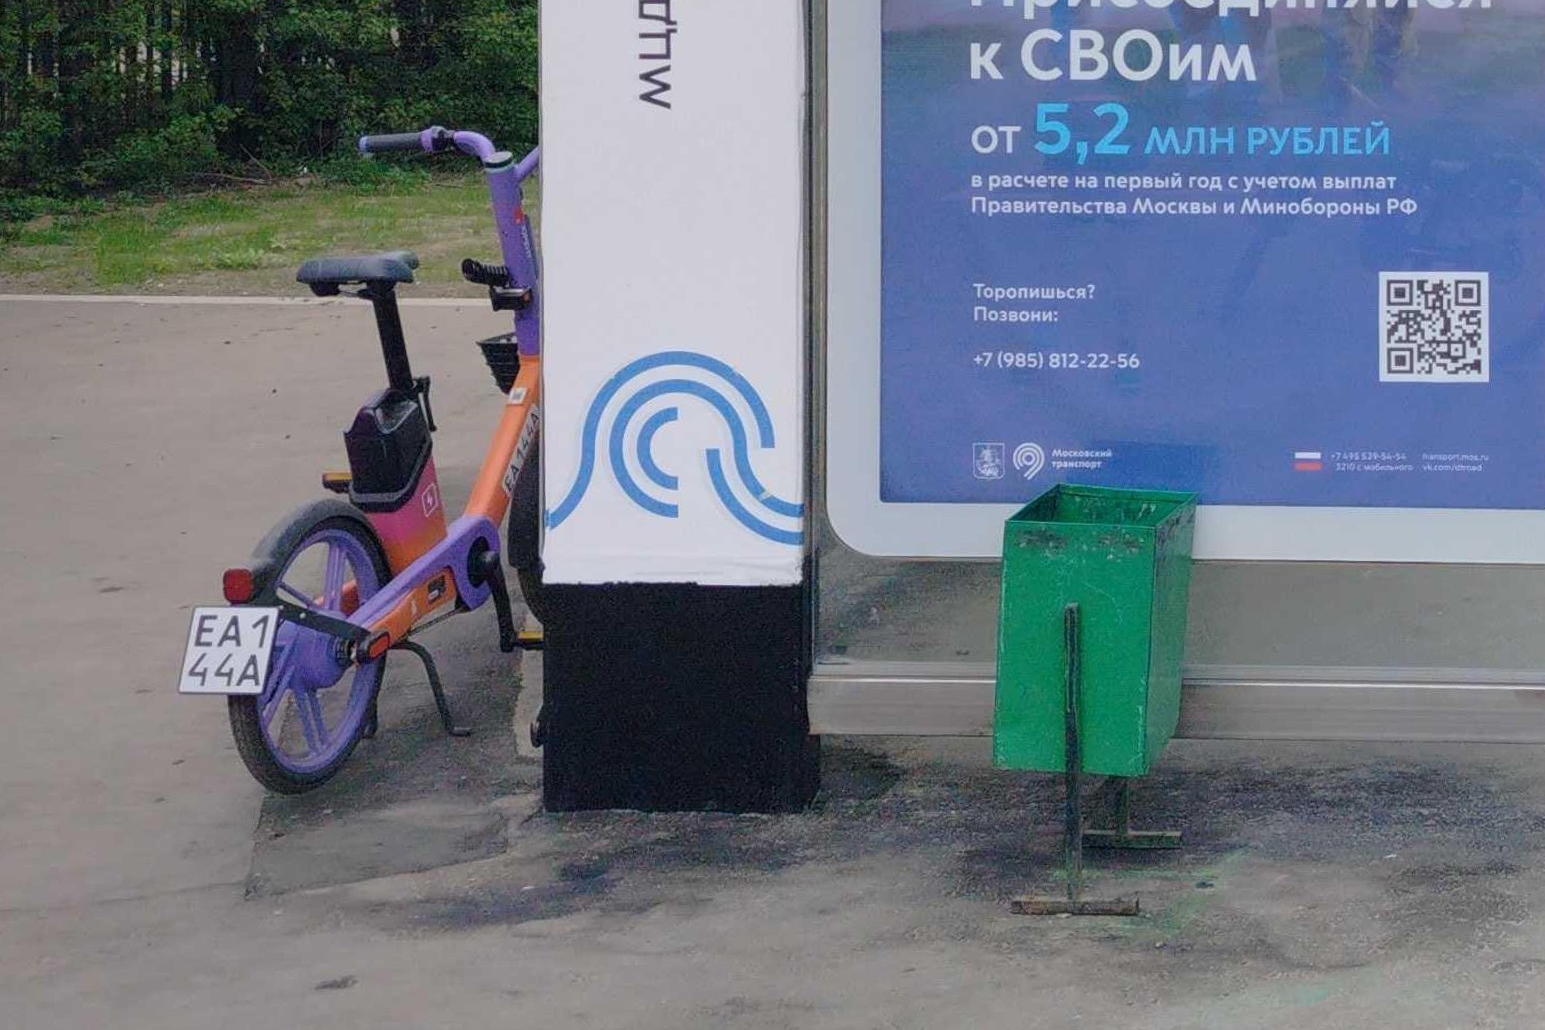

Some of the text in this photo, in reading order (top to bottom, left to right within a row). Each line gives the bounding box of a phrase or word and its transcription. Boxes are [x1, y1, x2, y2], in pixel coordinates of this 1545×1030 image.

[970, 28, 1257, 81] к СВОим
[1034, 102, 1131, 165] 5,2
[1144, 126, 1235, 155] МЛН
[1247, 120, 1390, 156] РУБЛЕЙ
[971, 172, 1397, 193] в расчете на первый год с учетом выплат
[971, 196, 1418, 219] Правительства Москвы и Минобороны РФ
[973, 283, 1096, 302] Торопишься?
[974, 306, 1058, 323] Позвони:
[973, 351, 1140, 369] +7 (985) 812-22-56
[1051, 448, 1113, 459] Московский
[1051, 460, 1103, 471] транспорт
[188, 652, 261, 687] 44A
